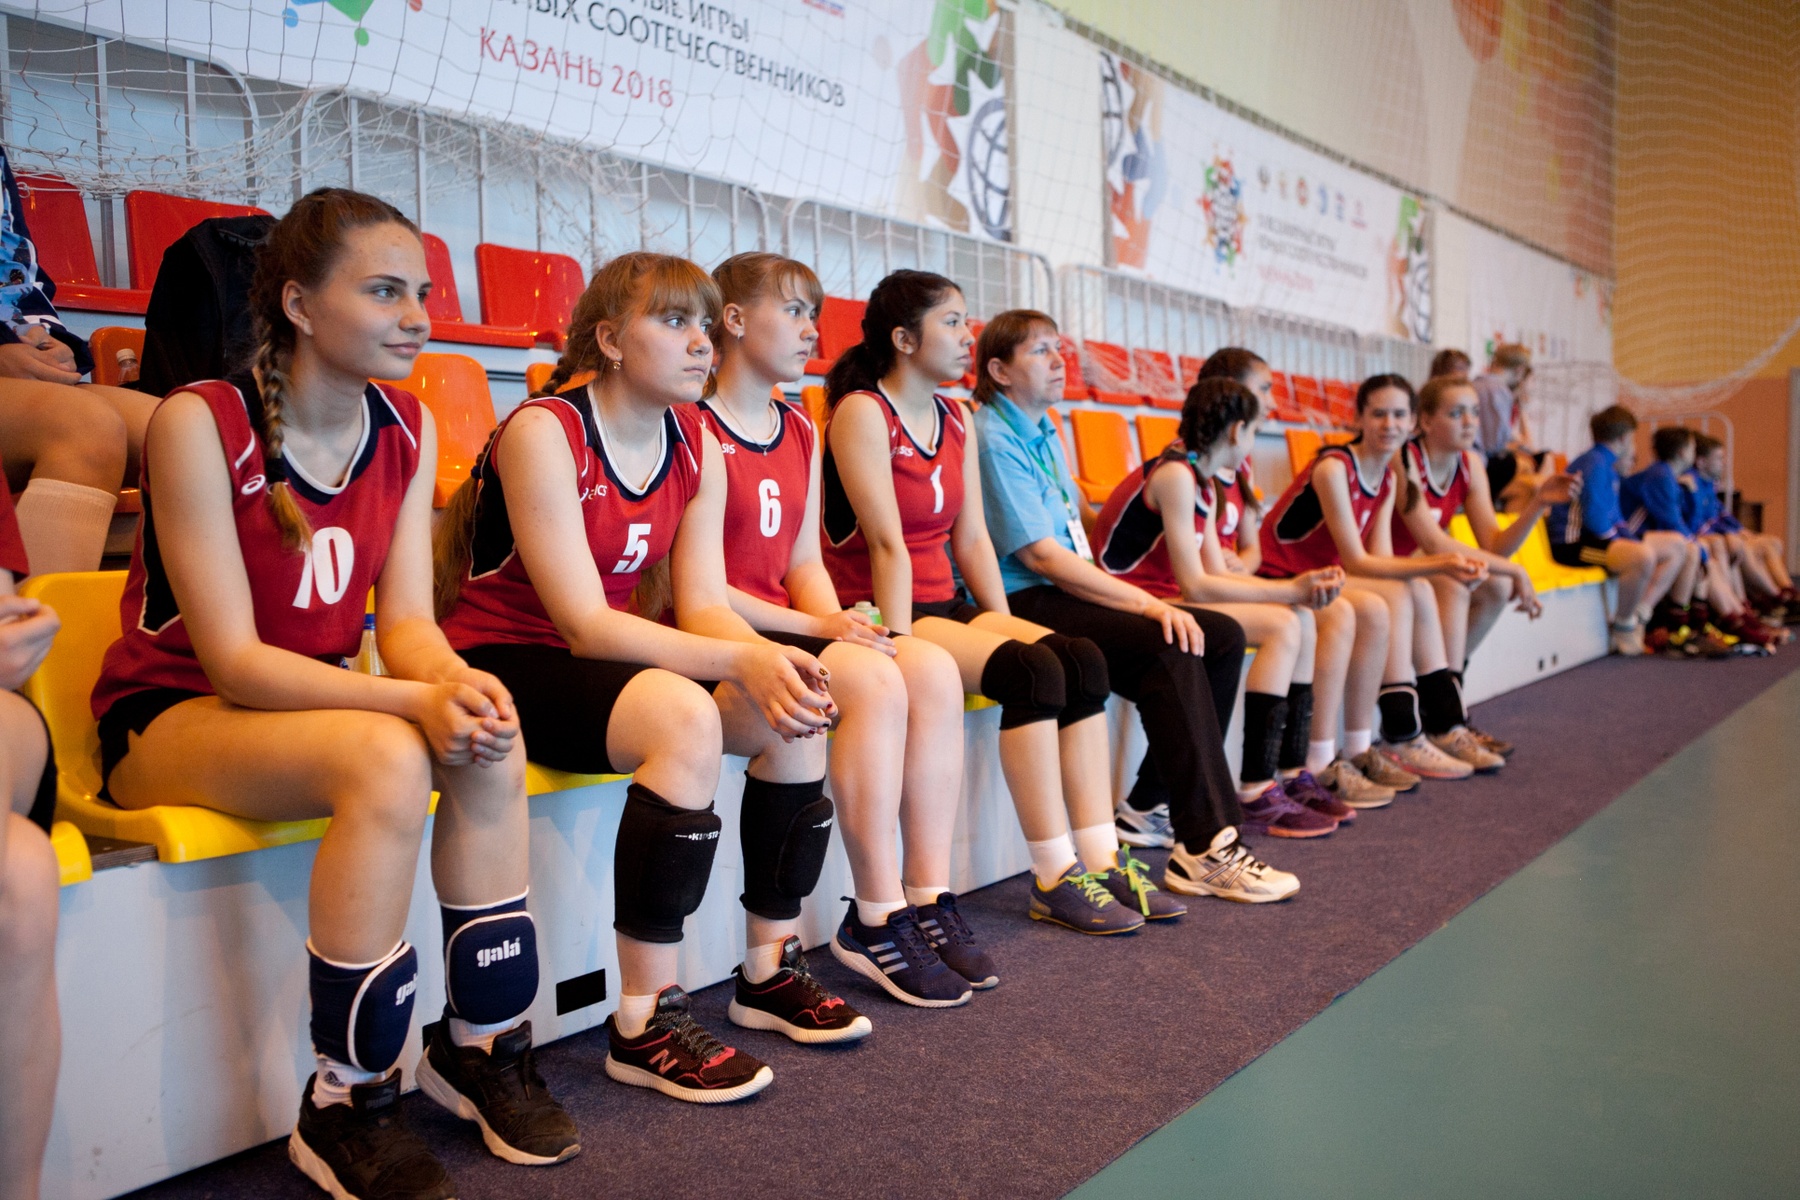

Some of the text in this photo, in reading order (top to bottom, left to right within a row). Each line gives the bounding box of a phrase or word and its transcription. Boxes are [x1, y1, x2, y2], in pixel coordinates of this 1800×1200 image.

[689, 1, 749, 42] ИГРЫ
[479, 27, 674, 108] КАЗАНЬ 2018
[588, 1, 846, 107] СООТЕЧЕСТВЕННИКОВ
[758, 478, 782, 538] 6
[930, 465, 944, 514] 1
[292, 526, 355, 610] 10
[611, 523, 652, 574] 5
